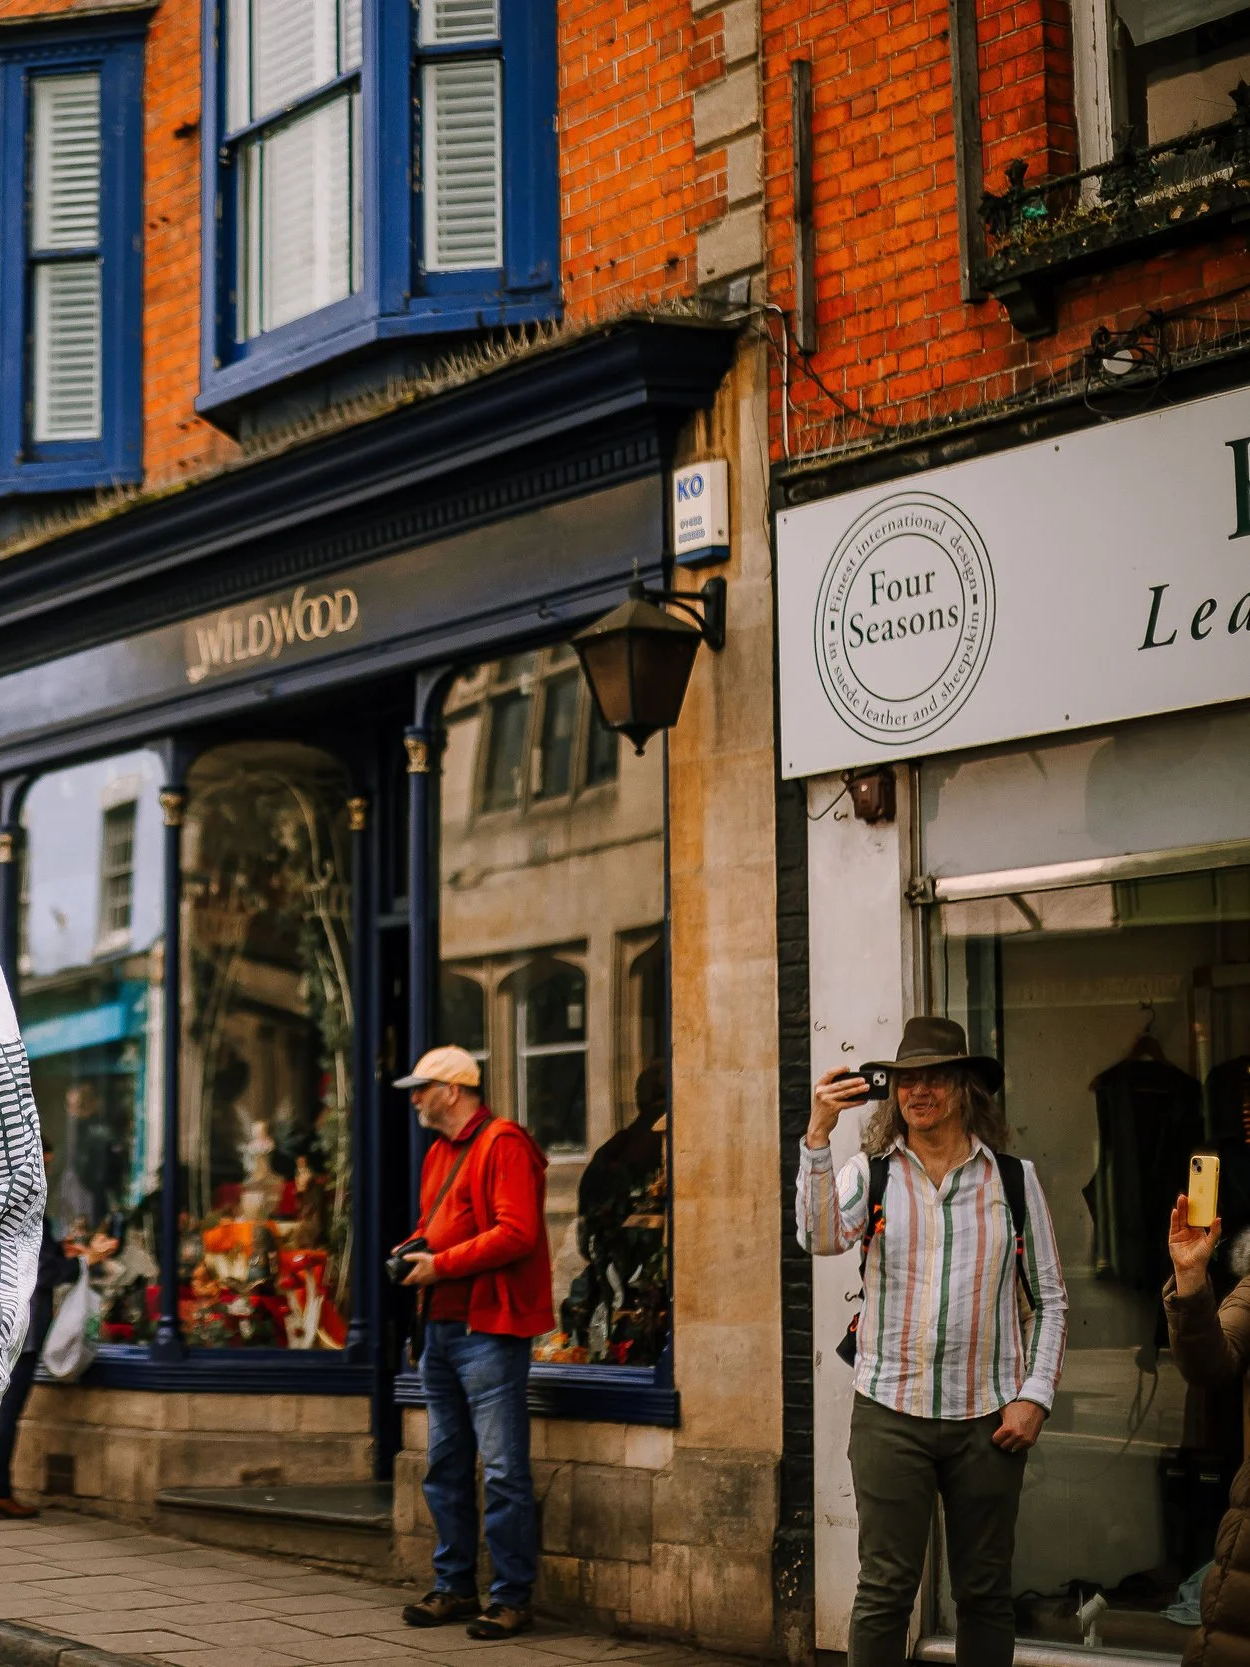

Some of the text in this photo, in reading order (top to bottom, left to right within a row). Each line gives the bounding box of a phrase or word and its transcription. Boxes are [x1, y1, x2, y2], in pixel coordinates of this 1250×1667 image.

[830, 512, 979, 614] Finest international design
[869, 569, 936, 608] Four
[848, 604, 960, 649] Seasons
[828, 611, 980, 727] in suede leather and sheepskin
